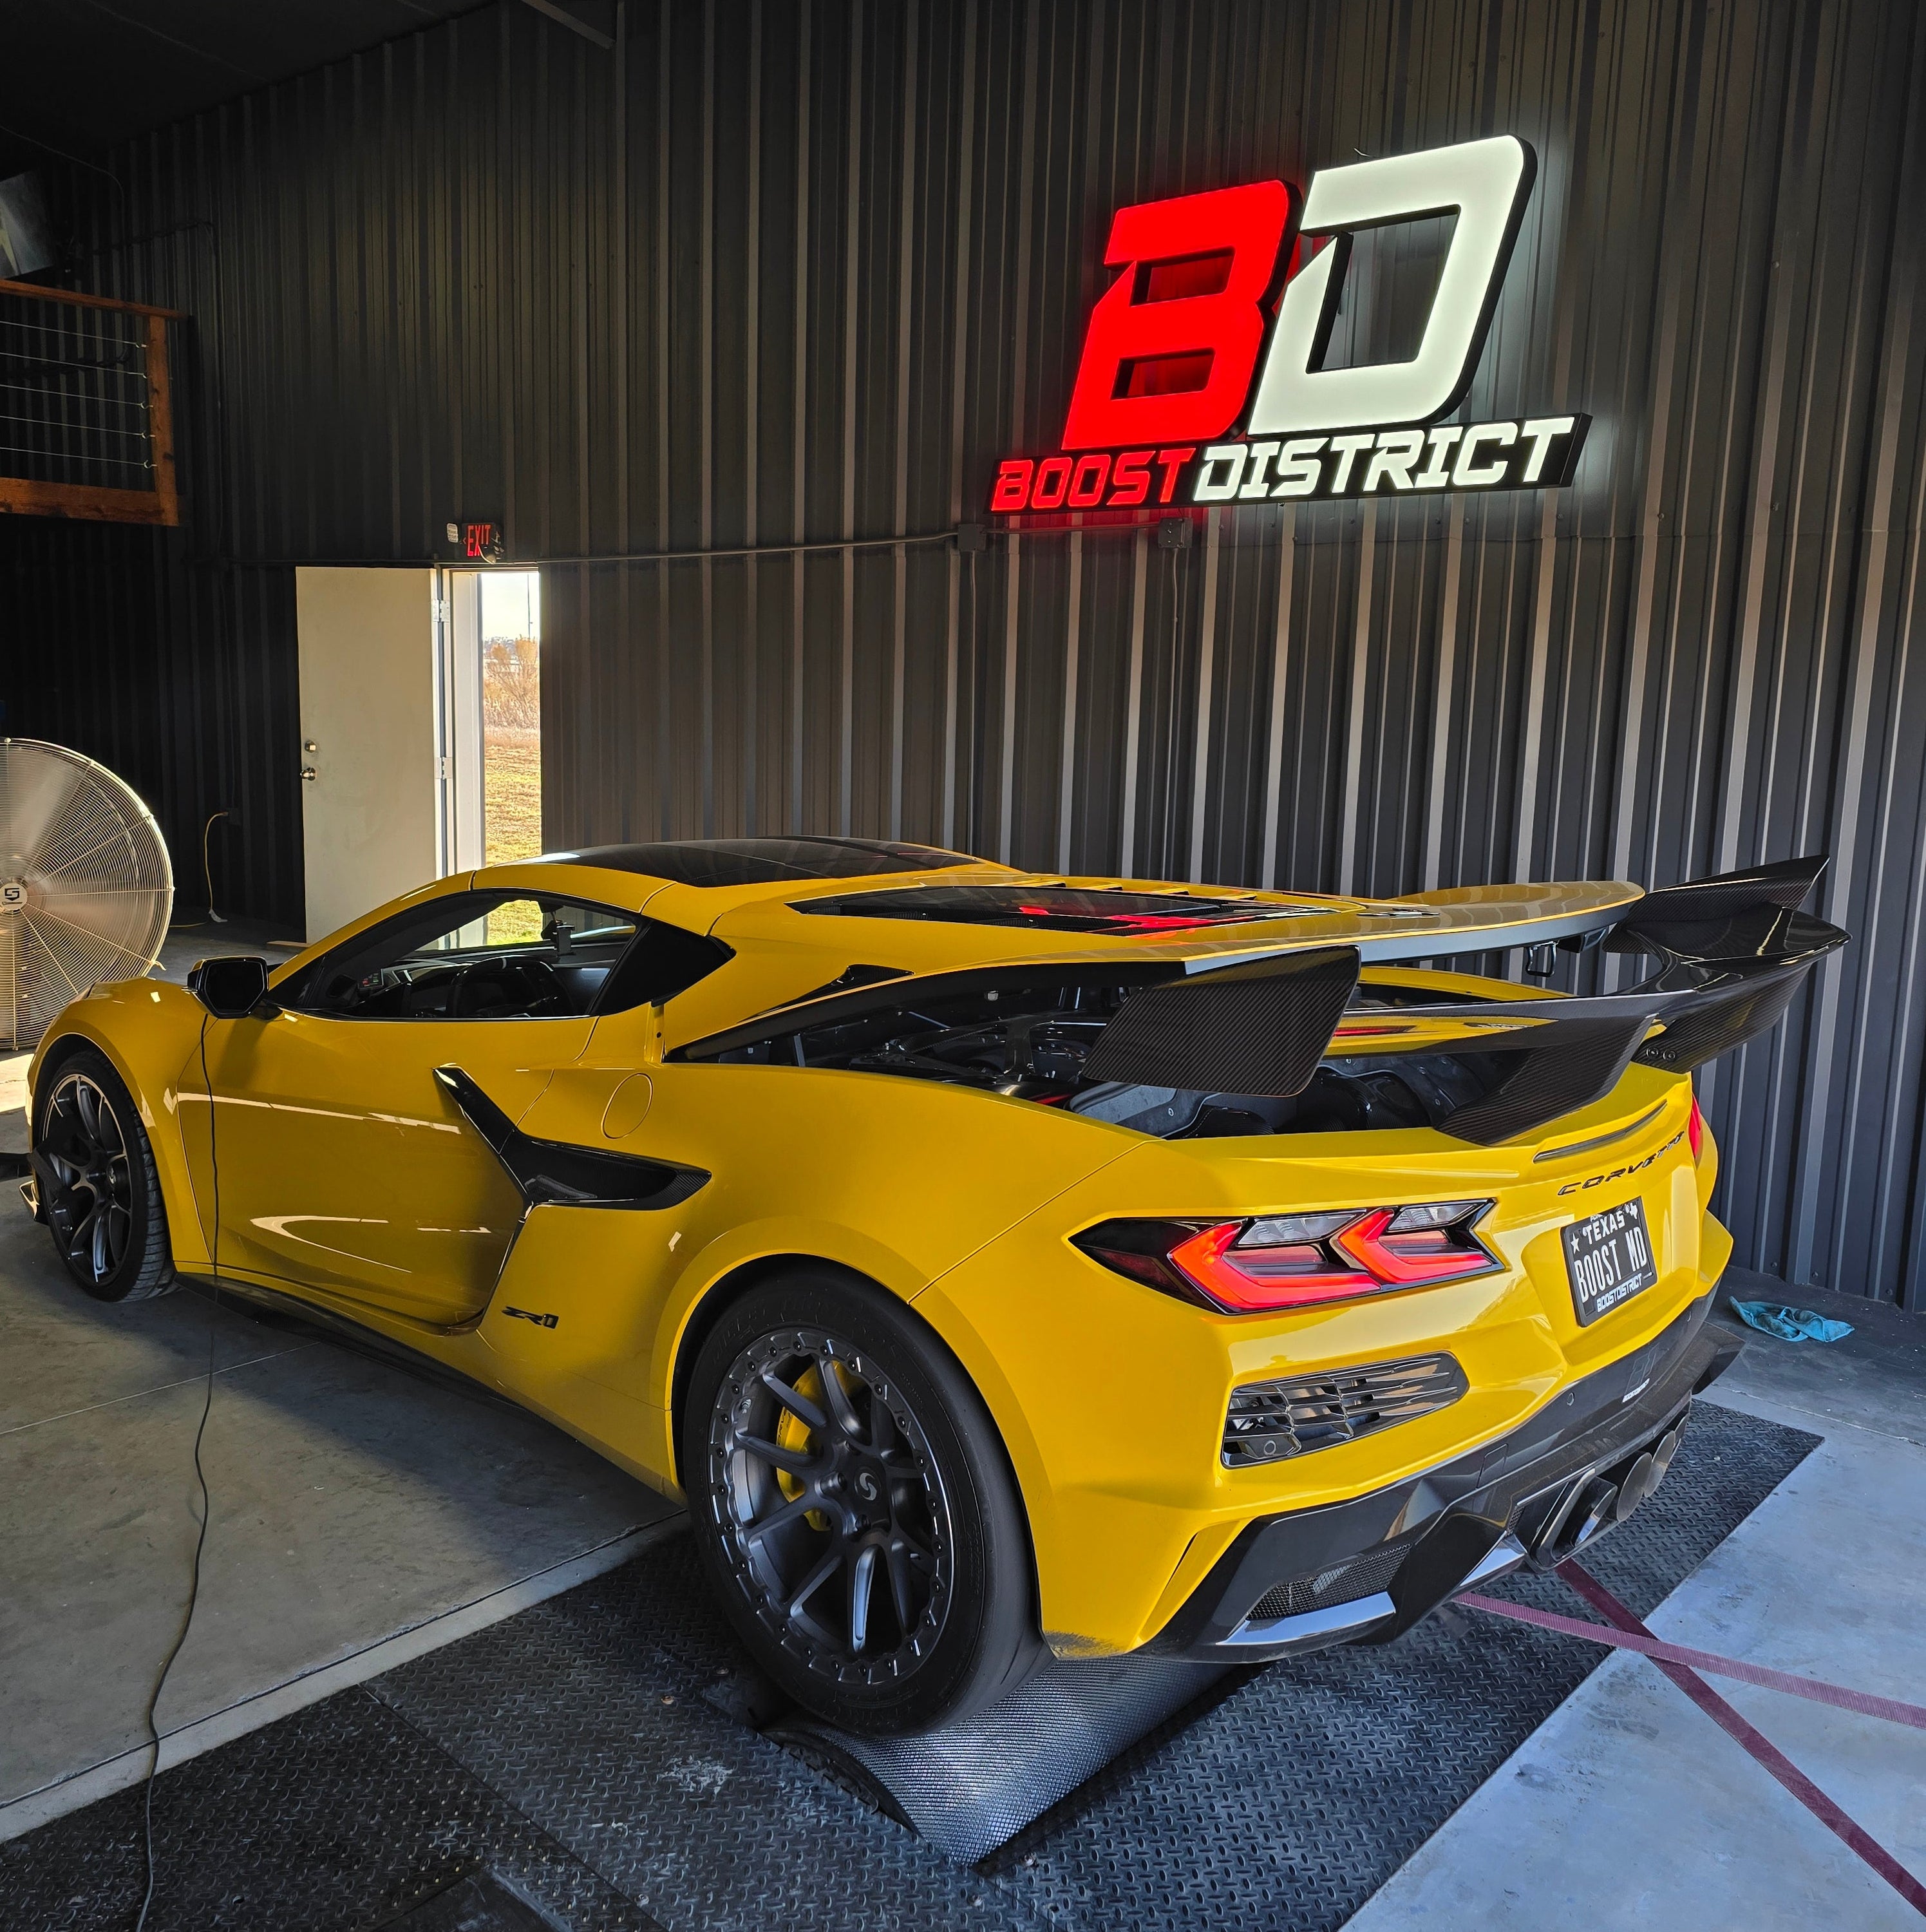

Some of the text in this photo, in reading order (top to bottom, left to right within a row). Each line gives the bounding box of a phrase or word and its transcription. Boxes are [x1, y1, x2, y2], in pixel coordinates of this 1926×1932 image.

[1061, 135, 1526, 450] BD
[991, 416, 1575, 511] BOOST DISTRICT
[467, 525, 491, 556] EXIT
[1557, 1131, 1685, 1196] CORVETTE
[1587, 1211, 1625, 1245] TEXAS
[1574, 1238, 1622, 1303] BOOST
